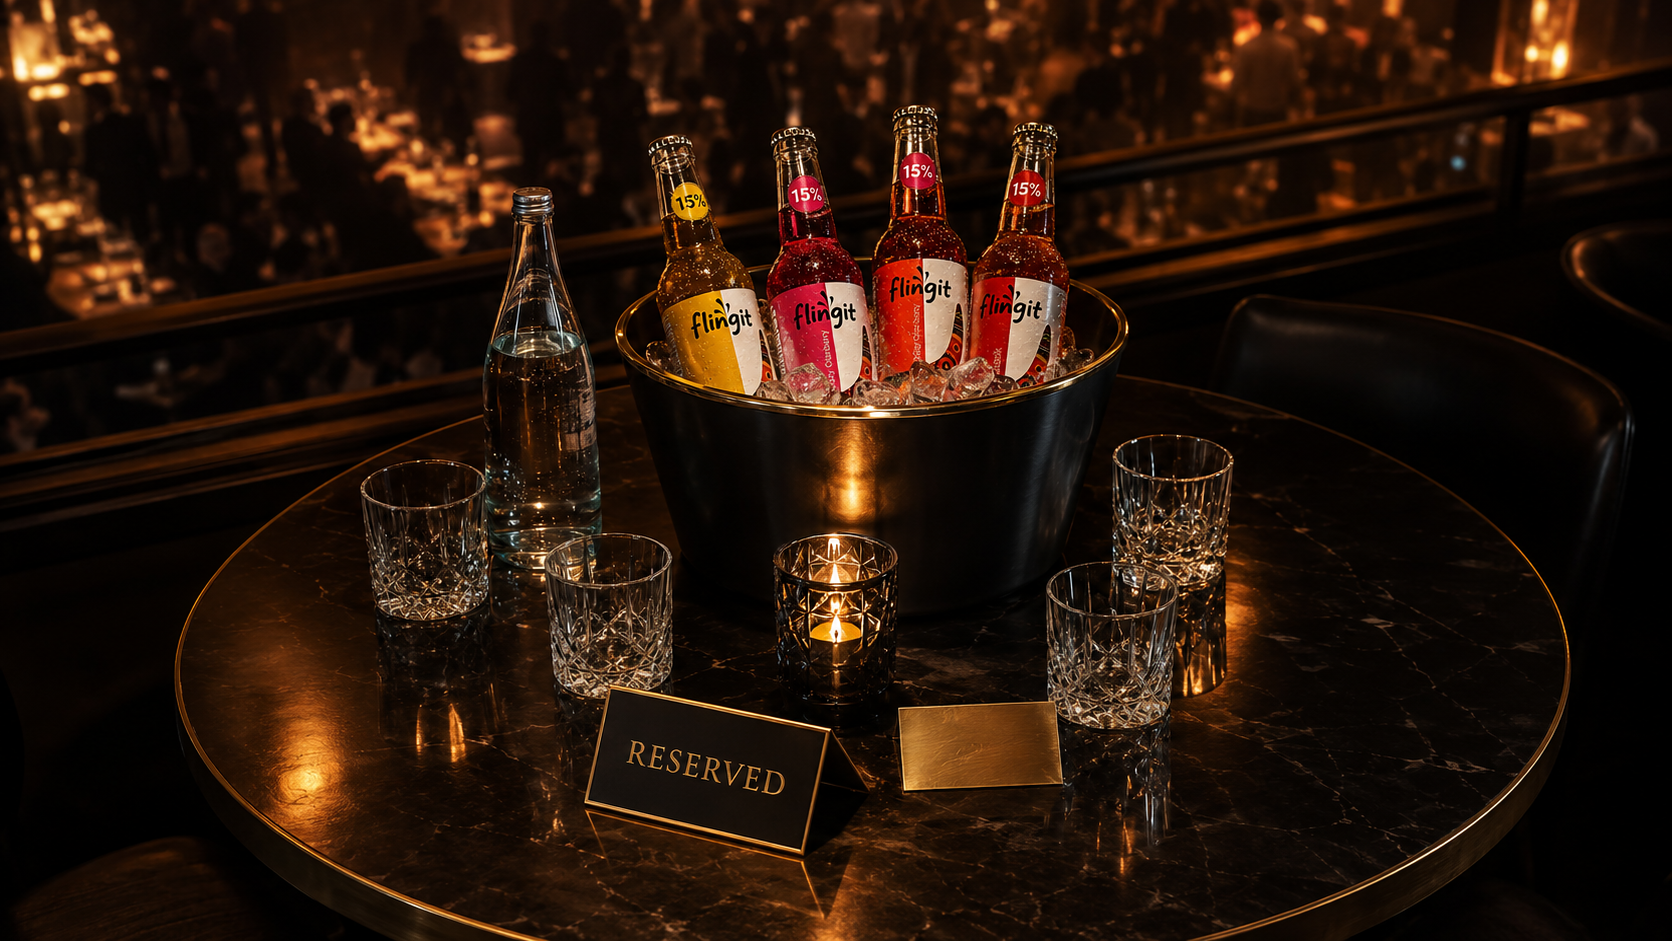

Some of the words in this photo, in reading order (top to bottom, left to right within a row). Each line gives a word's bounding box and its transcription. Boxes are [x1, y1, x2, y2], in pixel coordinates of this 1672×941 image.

[903, 164, 932, 179] 15%
[675, 194, 706, 211] 15%
[791, 187, 822, 203] 15%
[1012, 182, 1041, 197] 15%
[889, 277, 951, 303] flingit
[793, 303, 856, 330] flingit
[980, 294, 1042, 323] flingit
[691, 309, 752, 339] flingit
[626, 739, 786, 796] RESERVED
